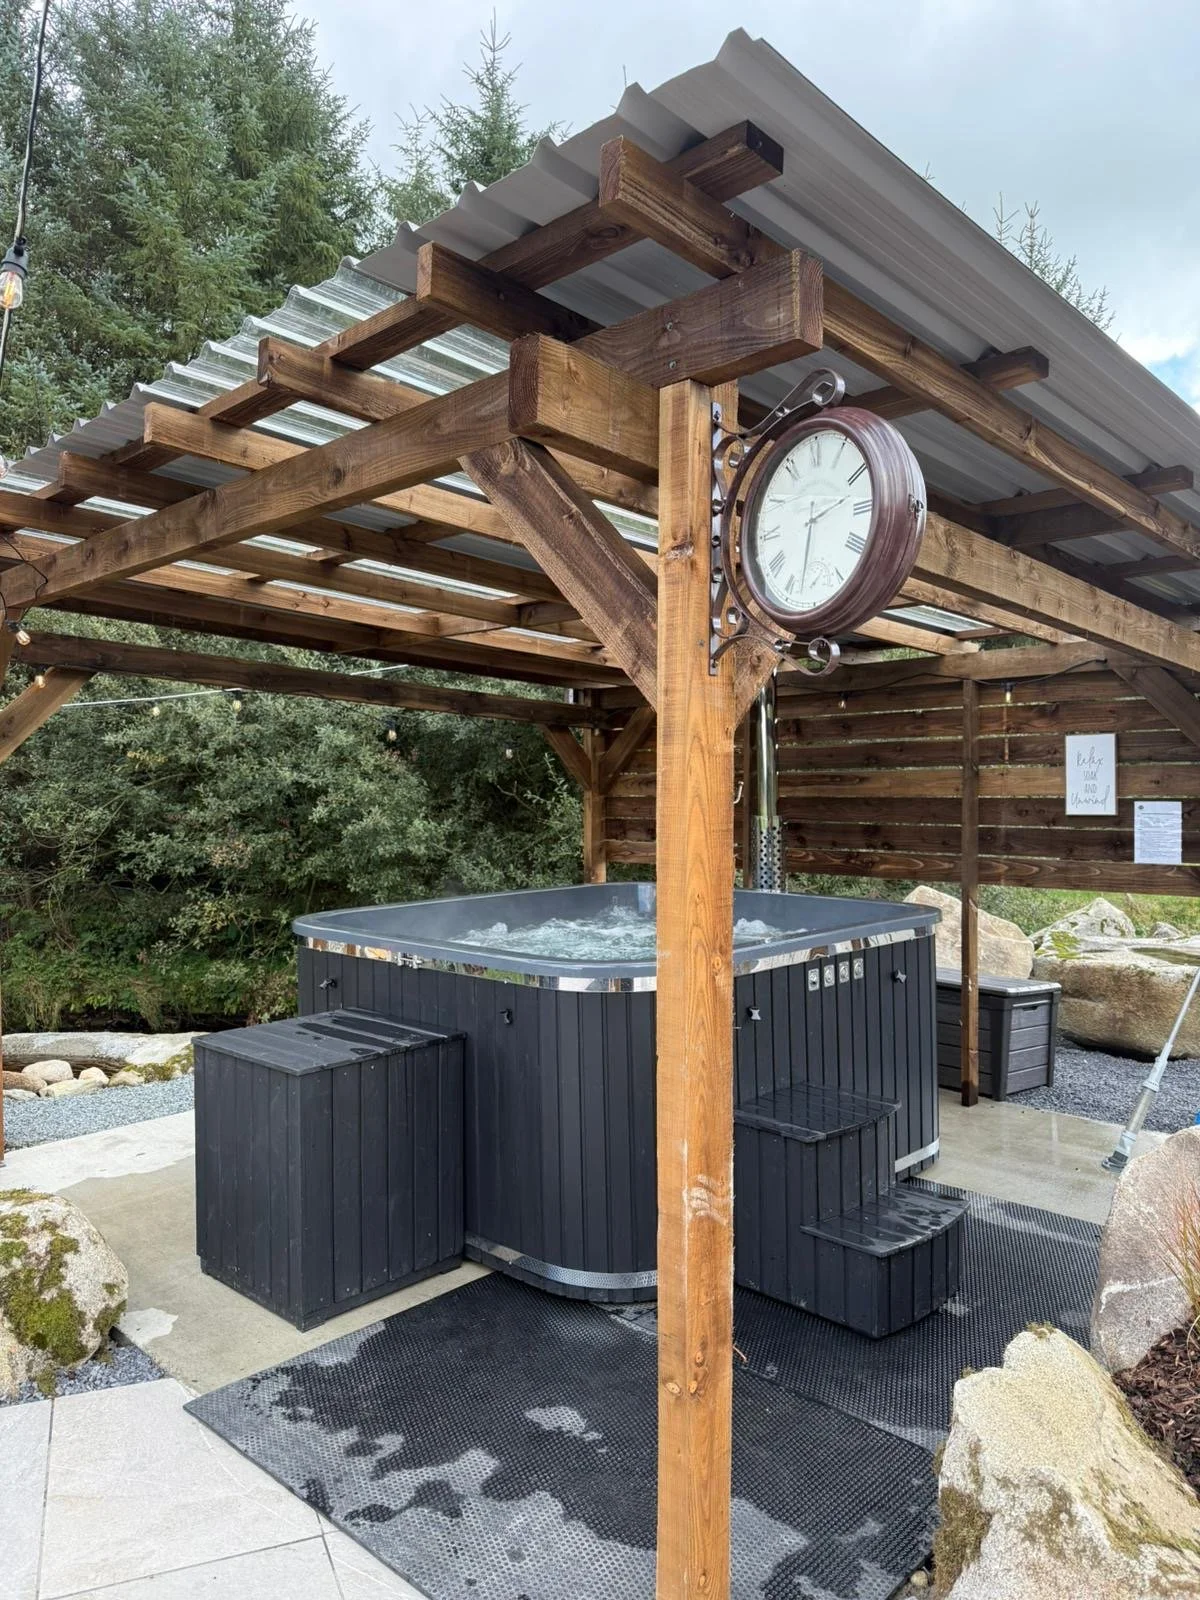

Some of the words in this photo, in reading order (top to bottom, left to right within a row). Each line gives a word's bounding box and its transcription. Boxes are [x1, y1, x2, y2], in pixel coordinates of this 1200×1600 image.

[853, 499, 873, 516] III
[1077, 746, 1104, 769] Relax
[1071, 784, 1111, 811] Unwind
[1084, 783, 1098, 794] AND
